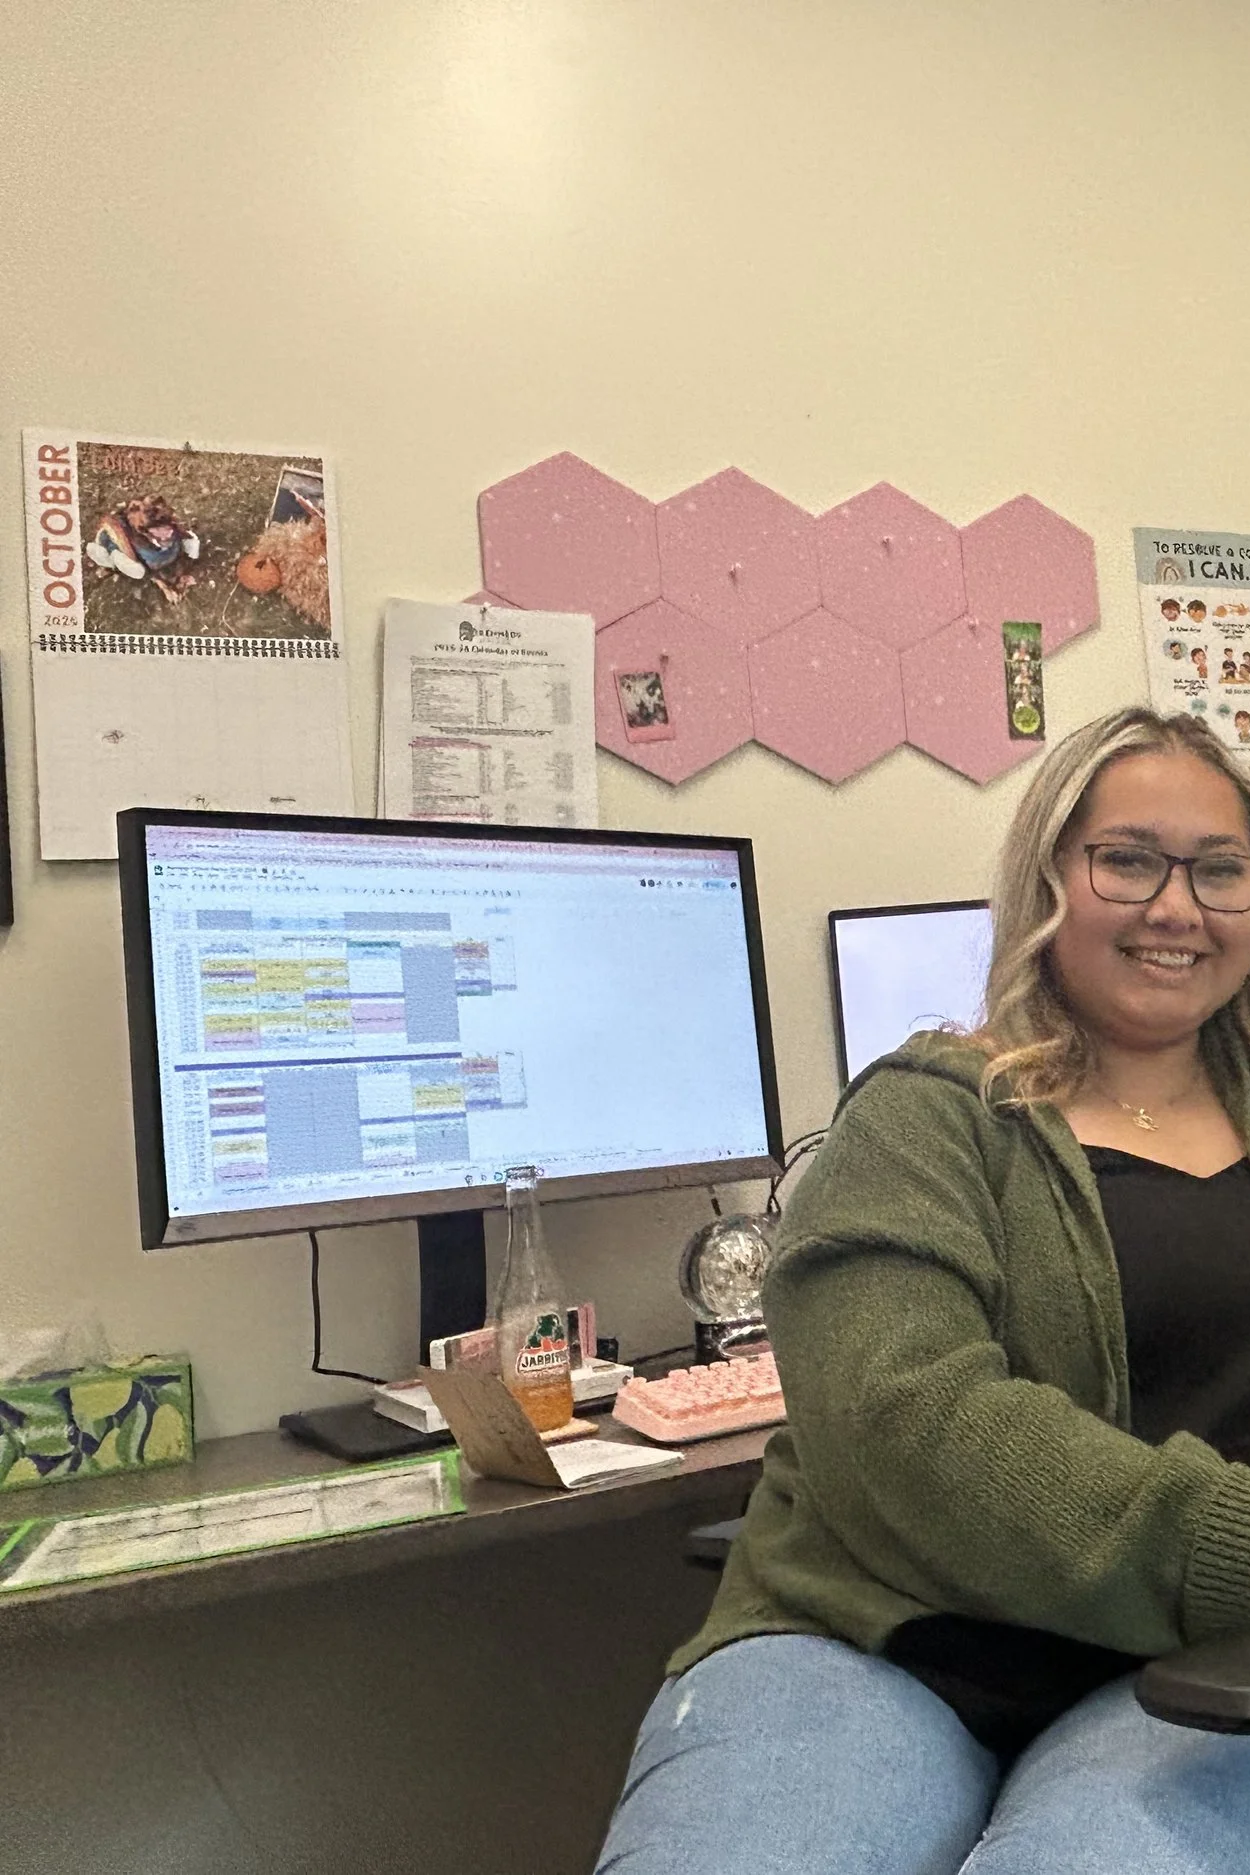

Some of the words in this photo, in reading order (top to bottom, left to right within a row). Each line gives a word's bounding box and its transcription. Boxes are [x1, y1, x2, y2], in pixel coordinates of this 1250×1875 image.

[38, 444, 77, 608] OCTOBER
[1153, 541, 1169, 553] TO
[1173, 543, 1221, 556] RESOLVE
[1188, 560, 1195, 578] I
